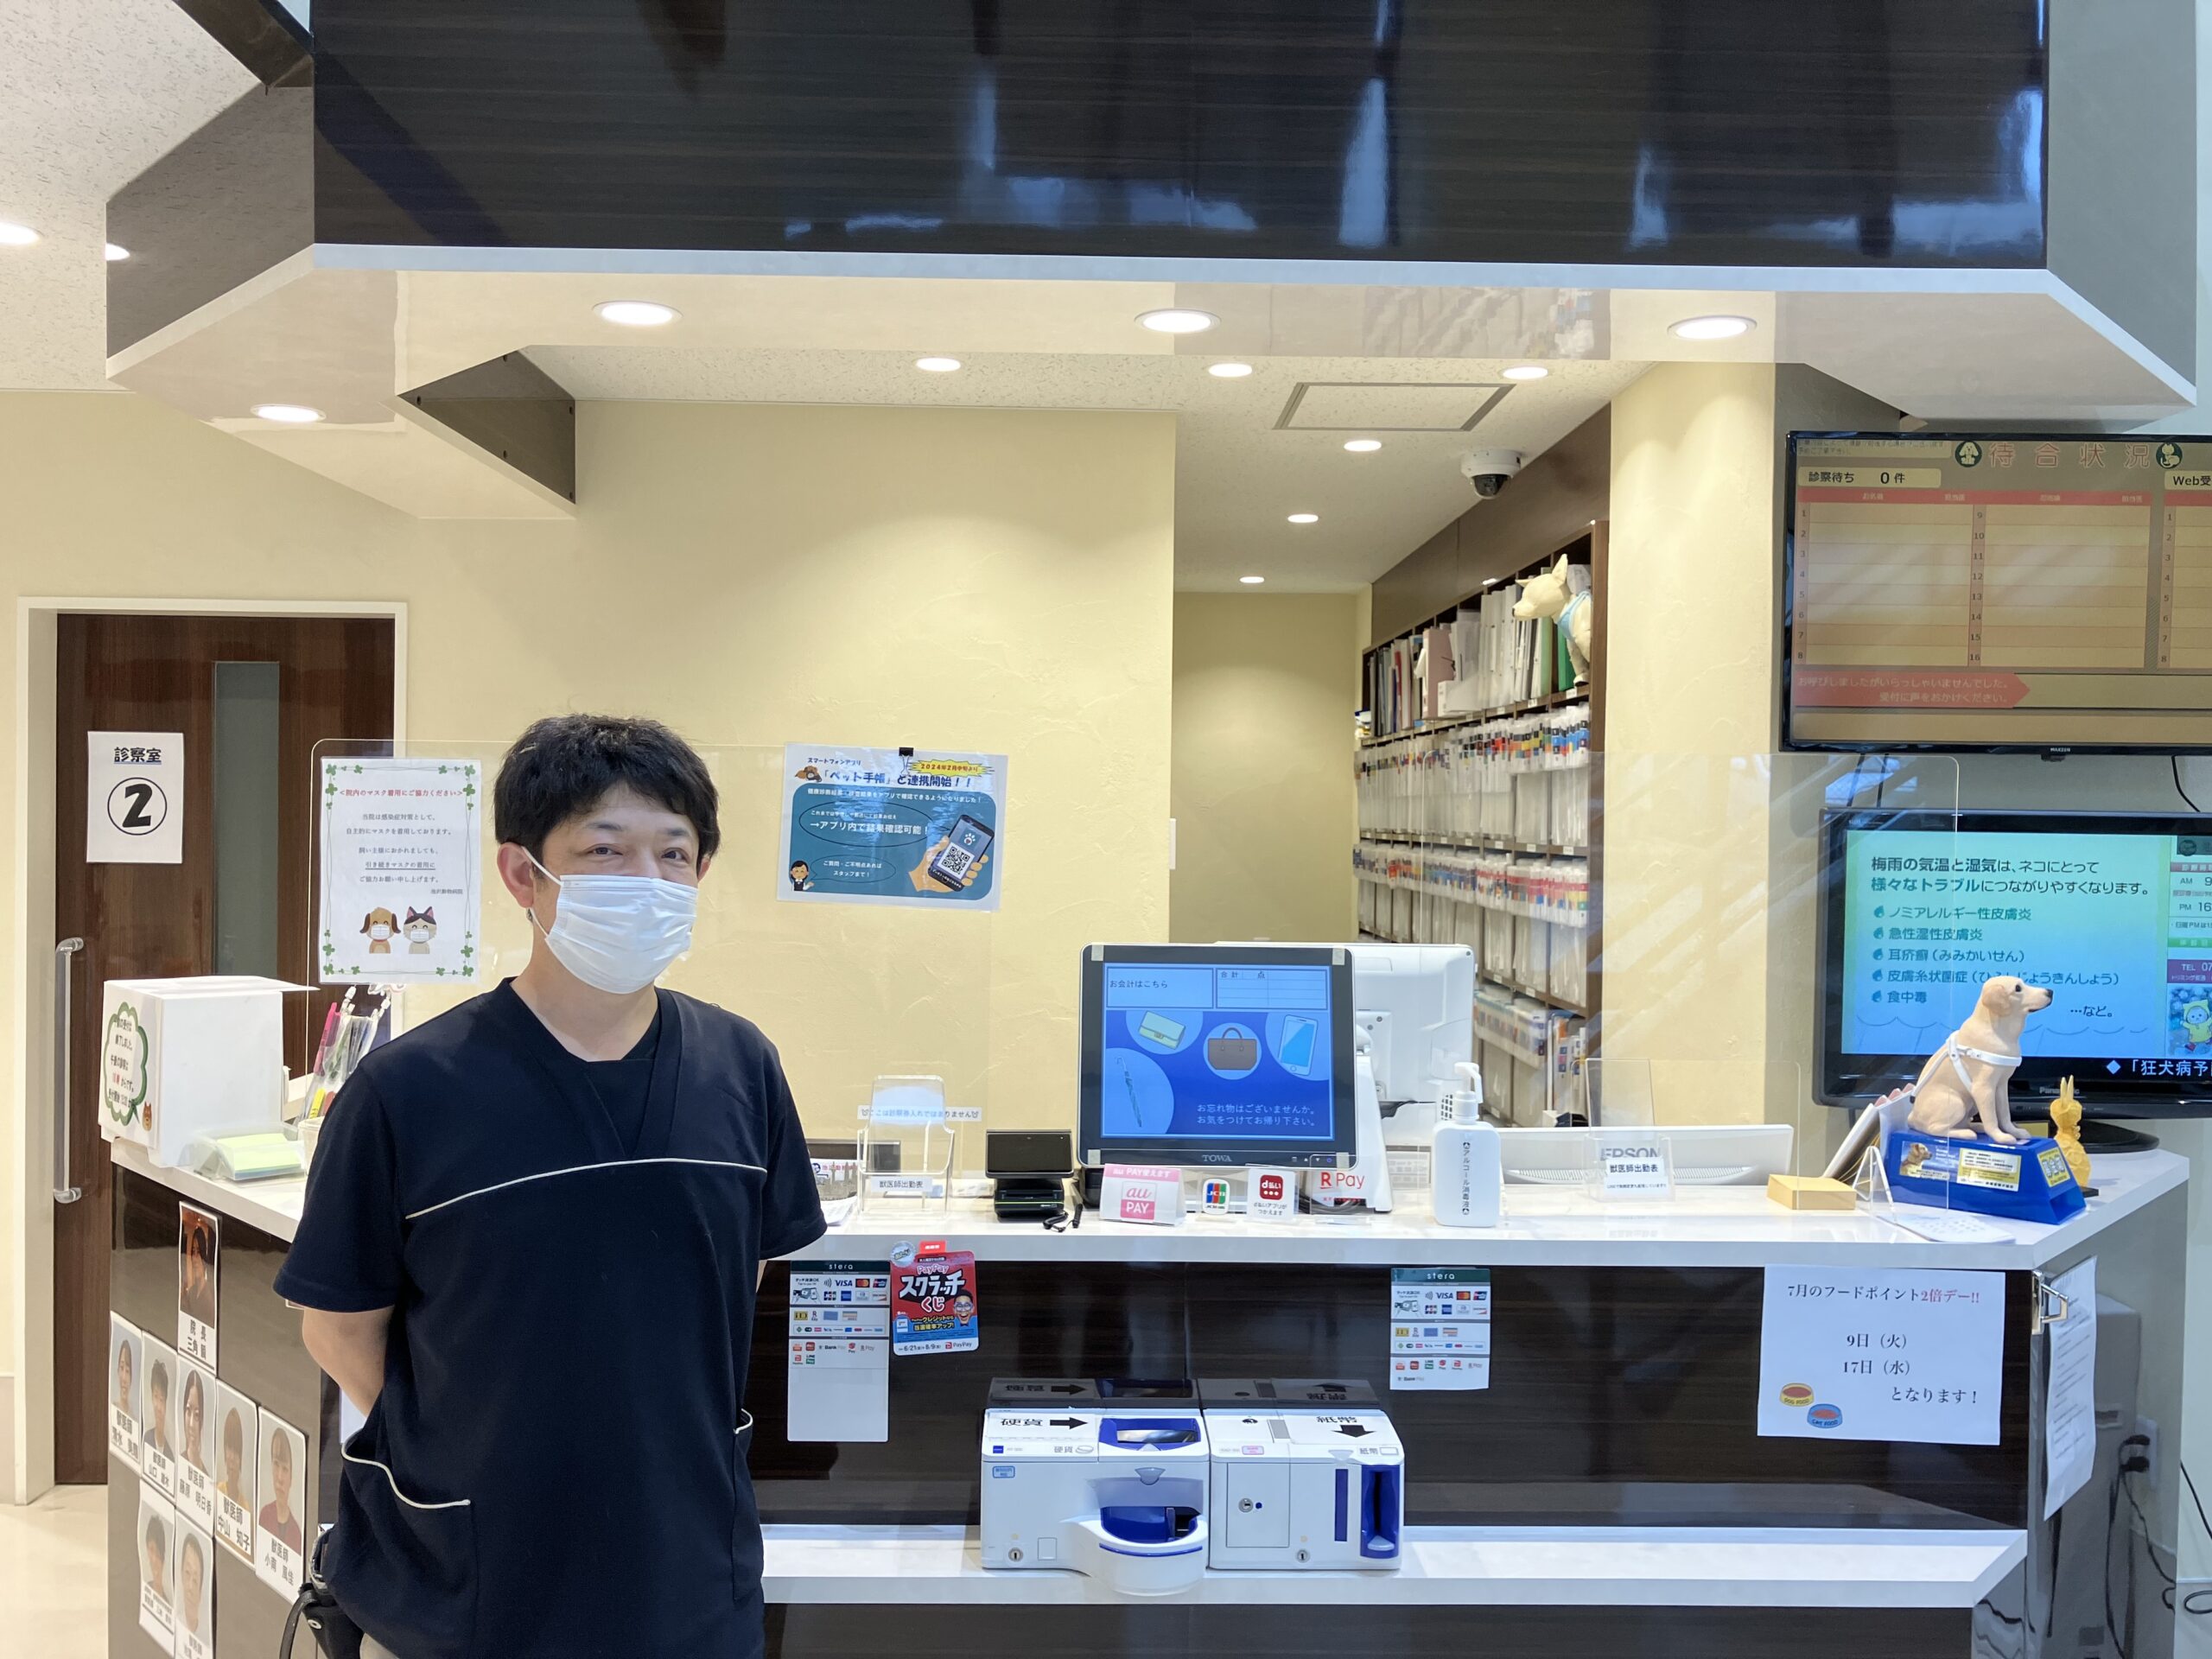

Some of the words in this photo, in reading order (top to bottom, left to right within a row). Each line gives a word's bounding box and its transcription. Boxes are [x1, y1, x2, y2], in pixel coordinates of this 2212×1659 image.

[1809, 472, 1854, 482] 診察待ち
[1880, 472, 1889, 484] 0
[1894, 473, 1905, 484] 件
[1879, 693, 2008, 703] 受付に声をおかけください。
[113, 747, 162, 762] 診察室
[1872, 855, 2100, 874] 梅雨の気温と湿気は、ネコにとって
[1872, 876, 2149, 895] 様々なトラブルにつながりやすくなります。
[1889, 906, 2031, 921] ノミアレルギー性皮膚炎
[1257, 971, 1265, 980] 点
[1109, 980, 1168, 988] お会計はこちら
[1887, 991, 1927, 1004] 食中毒
[2133, 1059, 2212, 1077] 「狂犬病予
[1198, 1104, 1314, 1115] お忘れ物はございませんか。
[1198, 1116, 1315, 1127] お気をつけてお帰り下さい。
[1262, 1180, 1281, 1189] d払い
[1336, 1173, 1365, 1189] Pay
[1127, 1187, 1151, 1198] au
[1127, 1203, 1149, 1215] PAY
[917, 1263, 949, 1275] PayPay
[899, 1270, 966, 1298] スクラッチ
[1788, 1284, 1980, 1303] 7月のフードポイント2倍デー!!
[921, 1296, 945, 1313] くじ
[1891, 1387, 1977, 1404] となります！
[1001, 1418, 1042, 1427] 硬貨
[223, 1497, 244, 1526] 獣医師
[218, 1516, 232, 1537] 中山
[271, 1538, 289, 1564] 獣医師
